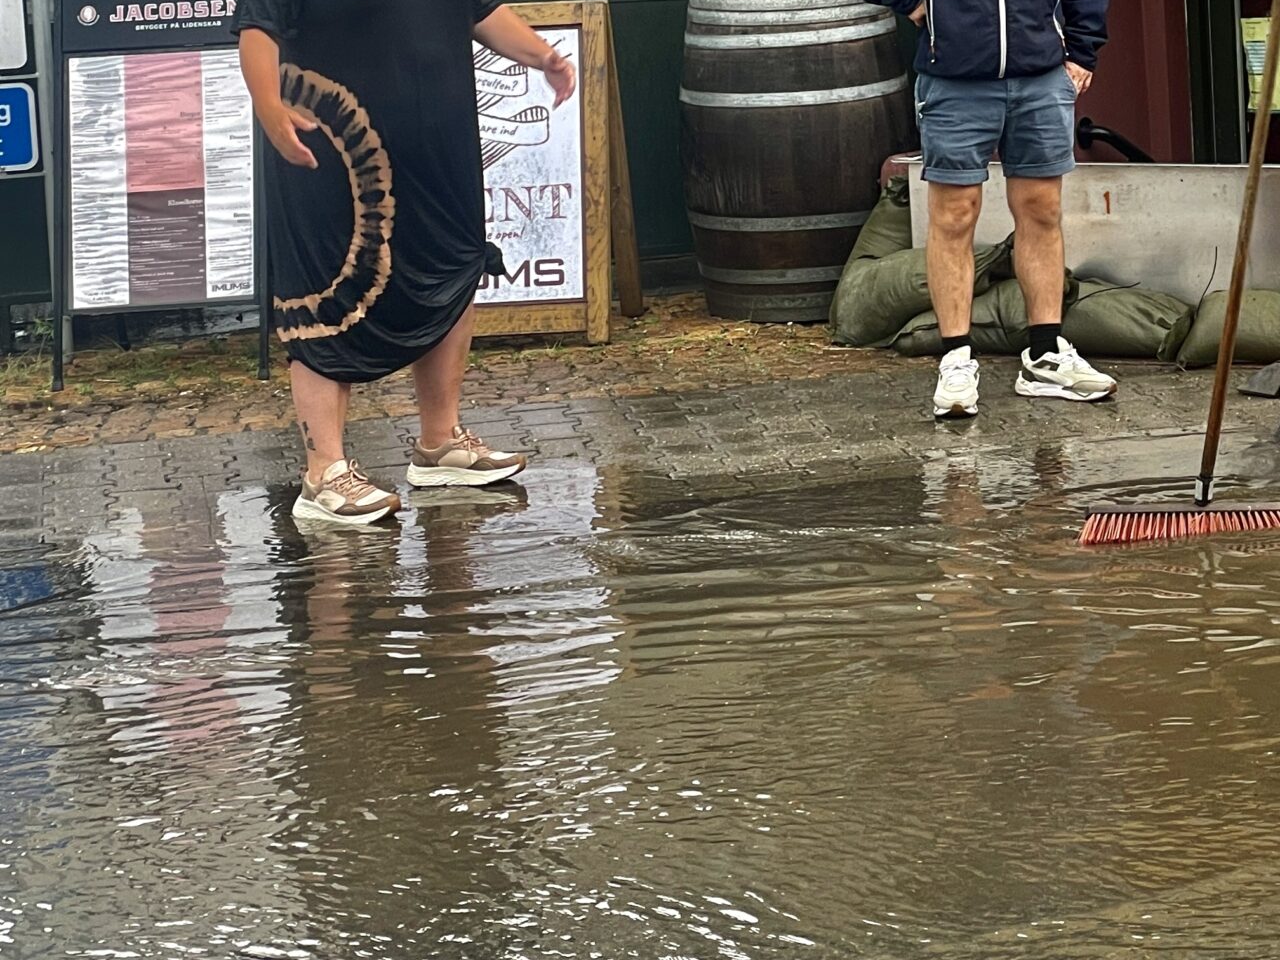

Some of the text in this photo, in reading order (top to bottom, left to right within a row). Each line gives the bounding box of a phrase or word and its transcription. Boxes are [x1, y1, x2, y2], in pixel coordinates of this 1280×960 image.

[135, 20, 222, 31] BRYGGET PÅ LIDENSKAB
[476, 78, 519, 92] rsulten?
[480, 125, 518, 136] are ind
[495, 222, 526, 242] open!
